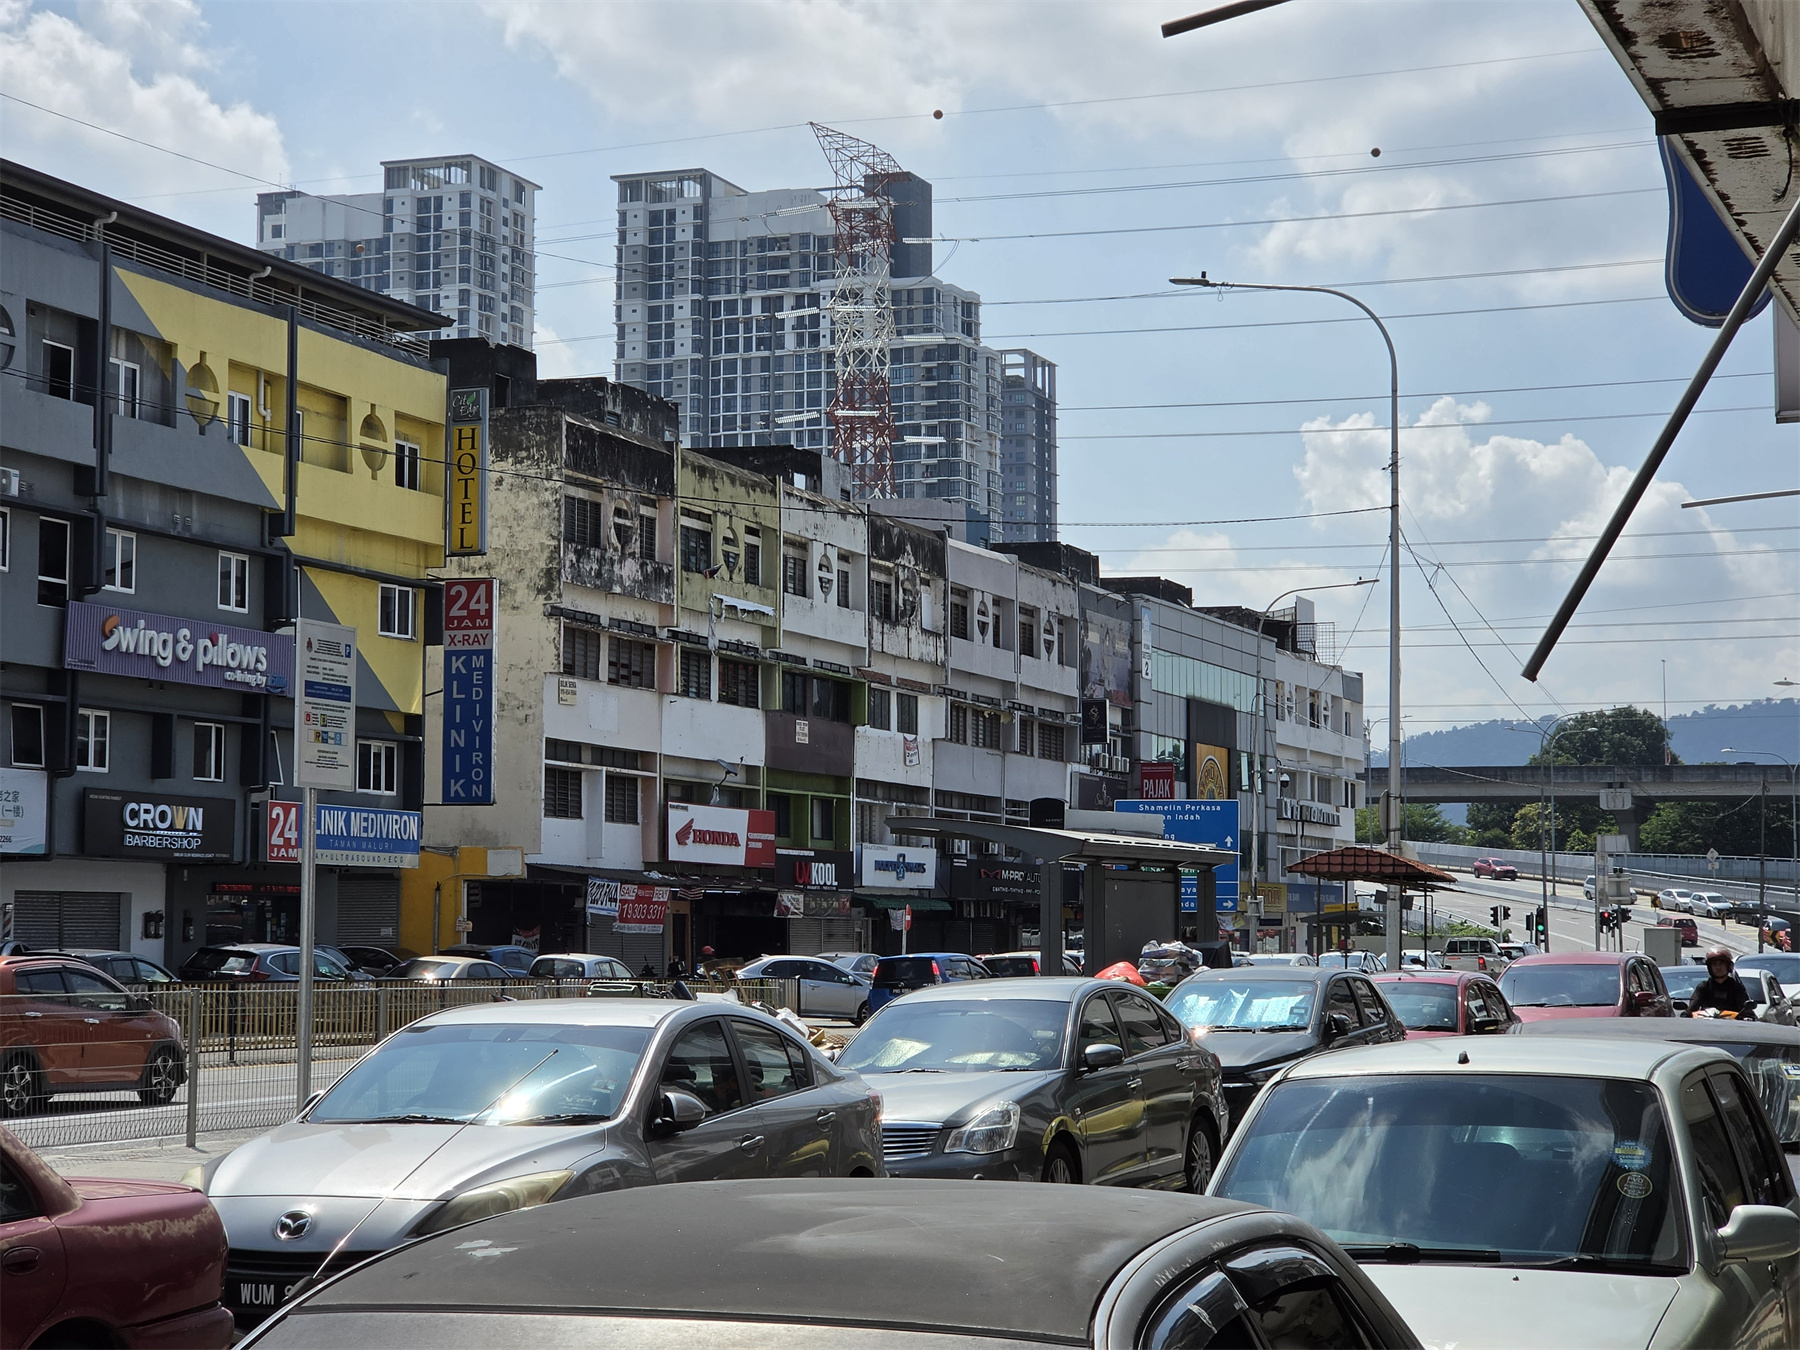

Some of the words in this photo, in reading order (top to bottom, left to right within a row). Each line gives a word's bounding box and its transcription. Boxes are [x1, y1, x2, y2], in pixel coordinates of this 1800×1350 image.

[456, 427, 477, 550] HOTEL
[448, 583, 489, 617] 24
[448, 618, 489, 628] JAM
[102, 615, 173, 667] Swing
[175, 628, 194, 662] &
[196, 632, 267, 672] pillows
[448, 633, 489, 647] X-RAY
[256, 672, 267, 688] by
[450, 655, 467, 797] KLINIK
[471, 655, 484, 797] MEDIVIRON
[1143, 778, 1171, 798] PAJAK
[123, 802, 204, 830] CROWN
[1175, 813, 1201, 821] Indah
[270, 806, 298, 846] 24
[315, 810, 348, 837] INIK
[350, 811, 418, 841] MEDIVIRON
[124, 834, 202, 850] BARBERSHOP
[329, 839, 356, 849] TAMAN
[361, 839, 393, 850] MALURI
[691, 829, 742, 847] HONDA
[270, 847, 298, 858] JAM
[329, 851, 381, 863] ULTRASOUND
[388, 854, 404, 864] ECG
[1001, 869, 1024, 881] M-PRO
[620, 886, 637, 897] SALE
[655, 888, 669, 899] RENT
[647, 904, 665, 920] 3311
[240, 1283, 275, 1305] WUM
